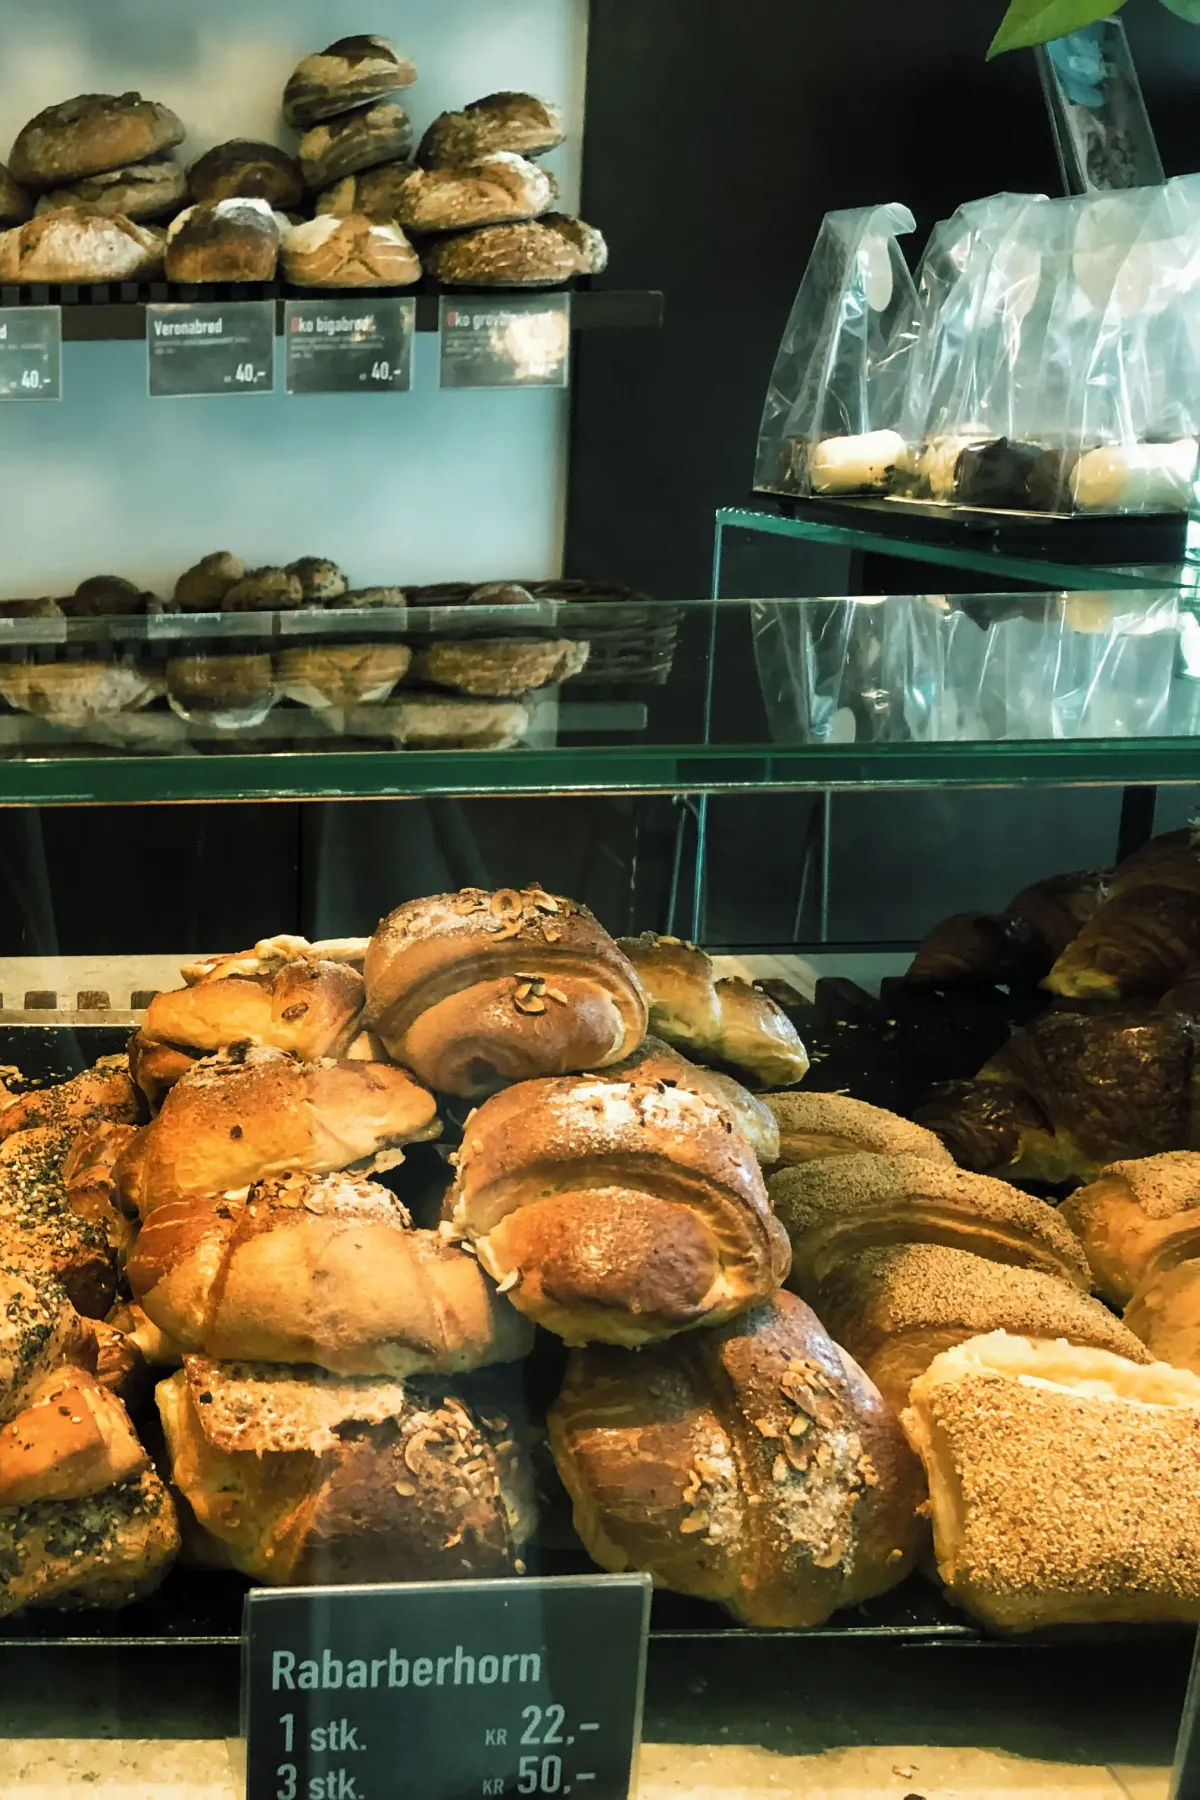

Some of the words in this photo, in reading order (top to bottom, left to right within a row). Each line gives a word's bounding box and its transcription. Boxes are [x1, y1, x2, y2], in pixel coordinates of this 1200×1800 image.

[154, 317, 223, 336] Veronabrød
[21, 369, 52, 390] 40,-
[235, 362, 267, 383] 40,-
[370, 360, 402, 381] 40,-
[271, 1644, 542, 1691] Rabarberhorn
[279, 1712, 294, 1752] 1
[310, 1717, 367, 1752] stk.
[485, 1727, 508, 1746] KR
[520, 1703, 600, 1745] 22,-
[276, 1763, 298, 1800] 3
[308, 1768, 365, 1800] stk.
[482, 1777, 505, 1796] KR
[517, 1754, 597, 1796] 50,-
